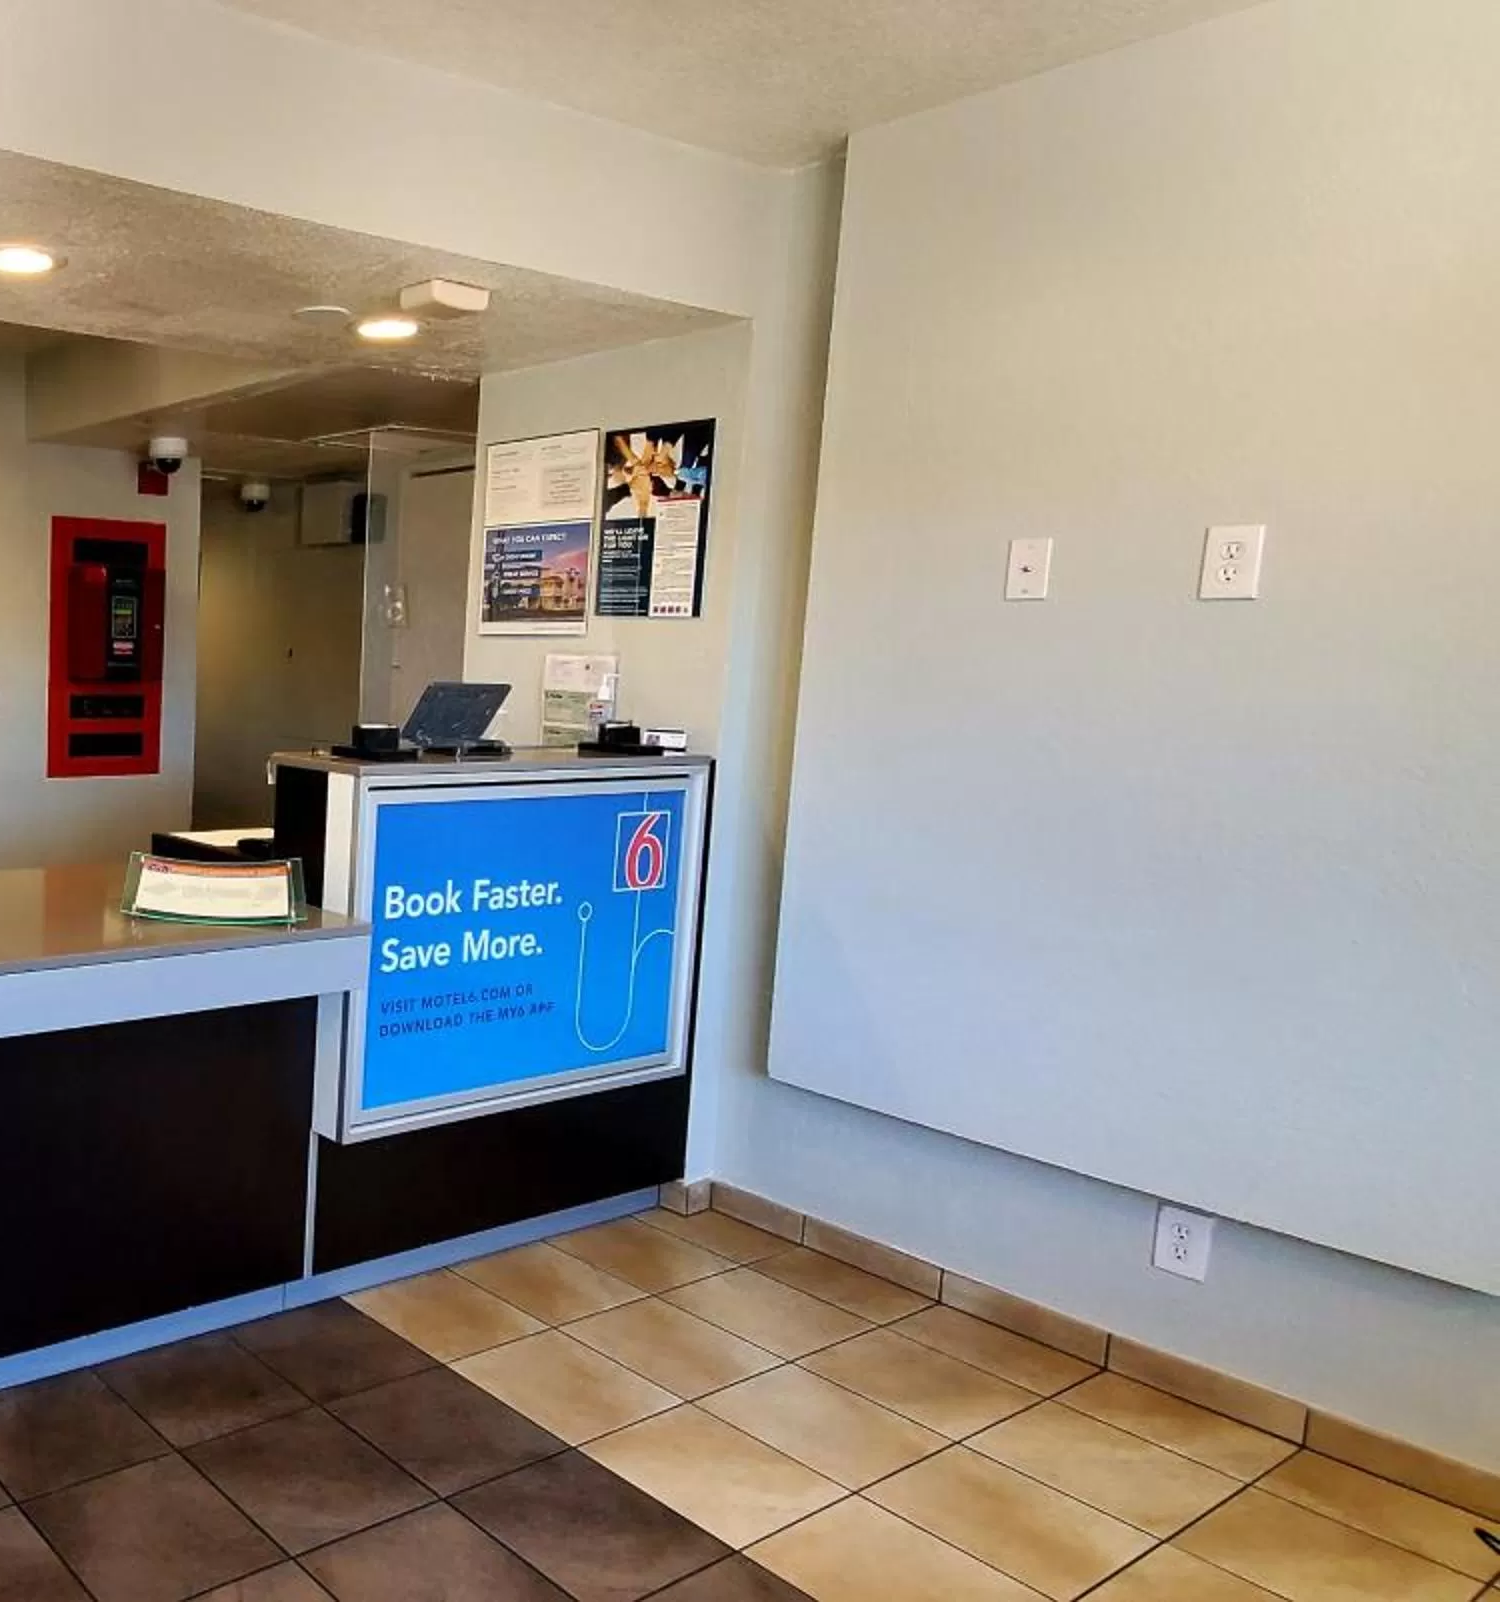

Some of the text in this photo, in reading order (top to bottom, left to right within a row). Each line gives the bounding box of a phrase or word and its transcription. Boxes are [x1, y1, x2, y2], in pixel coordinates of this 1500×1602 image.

[625, 813, 663, 890] 6
[385, 879, 563, 920] Book Faster.
[379, 928, 543, 974] Save More.
[379, 1001, 556, 1038] DOWNLOAD THE MY6 APP
[381, 983, 534, 1015] VISIT MOTEL6.COM OR
